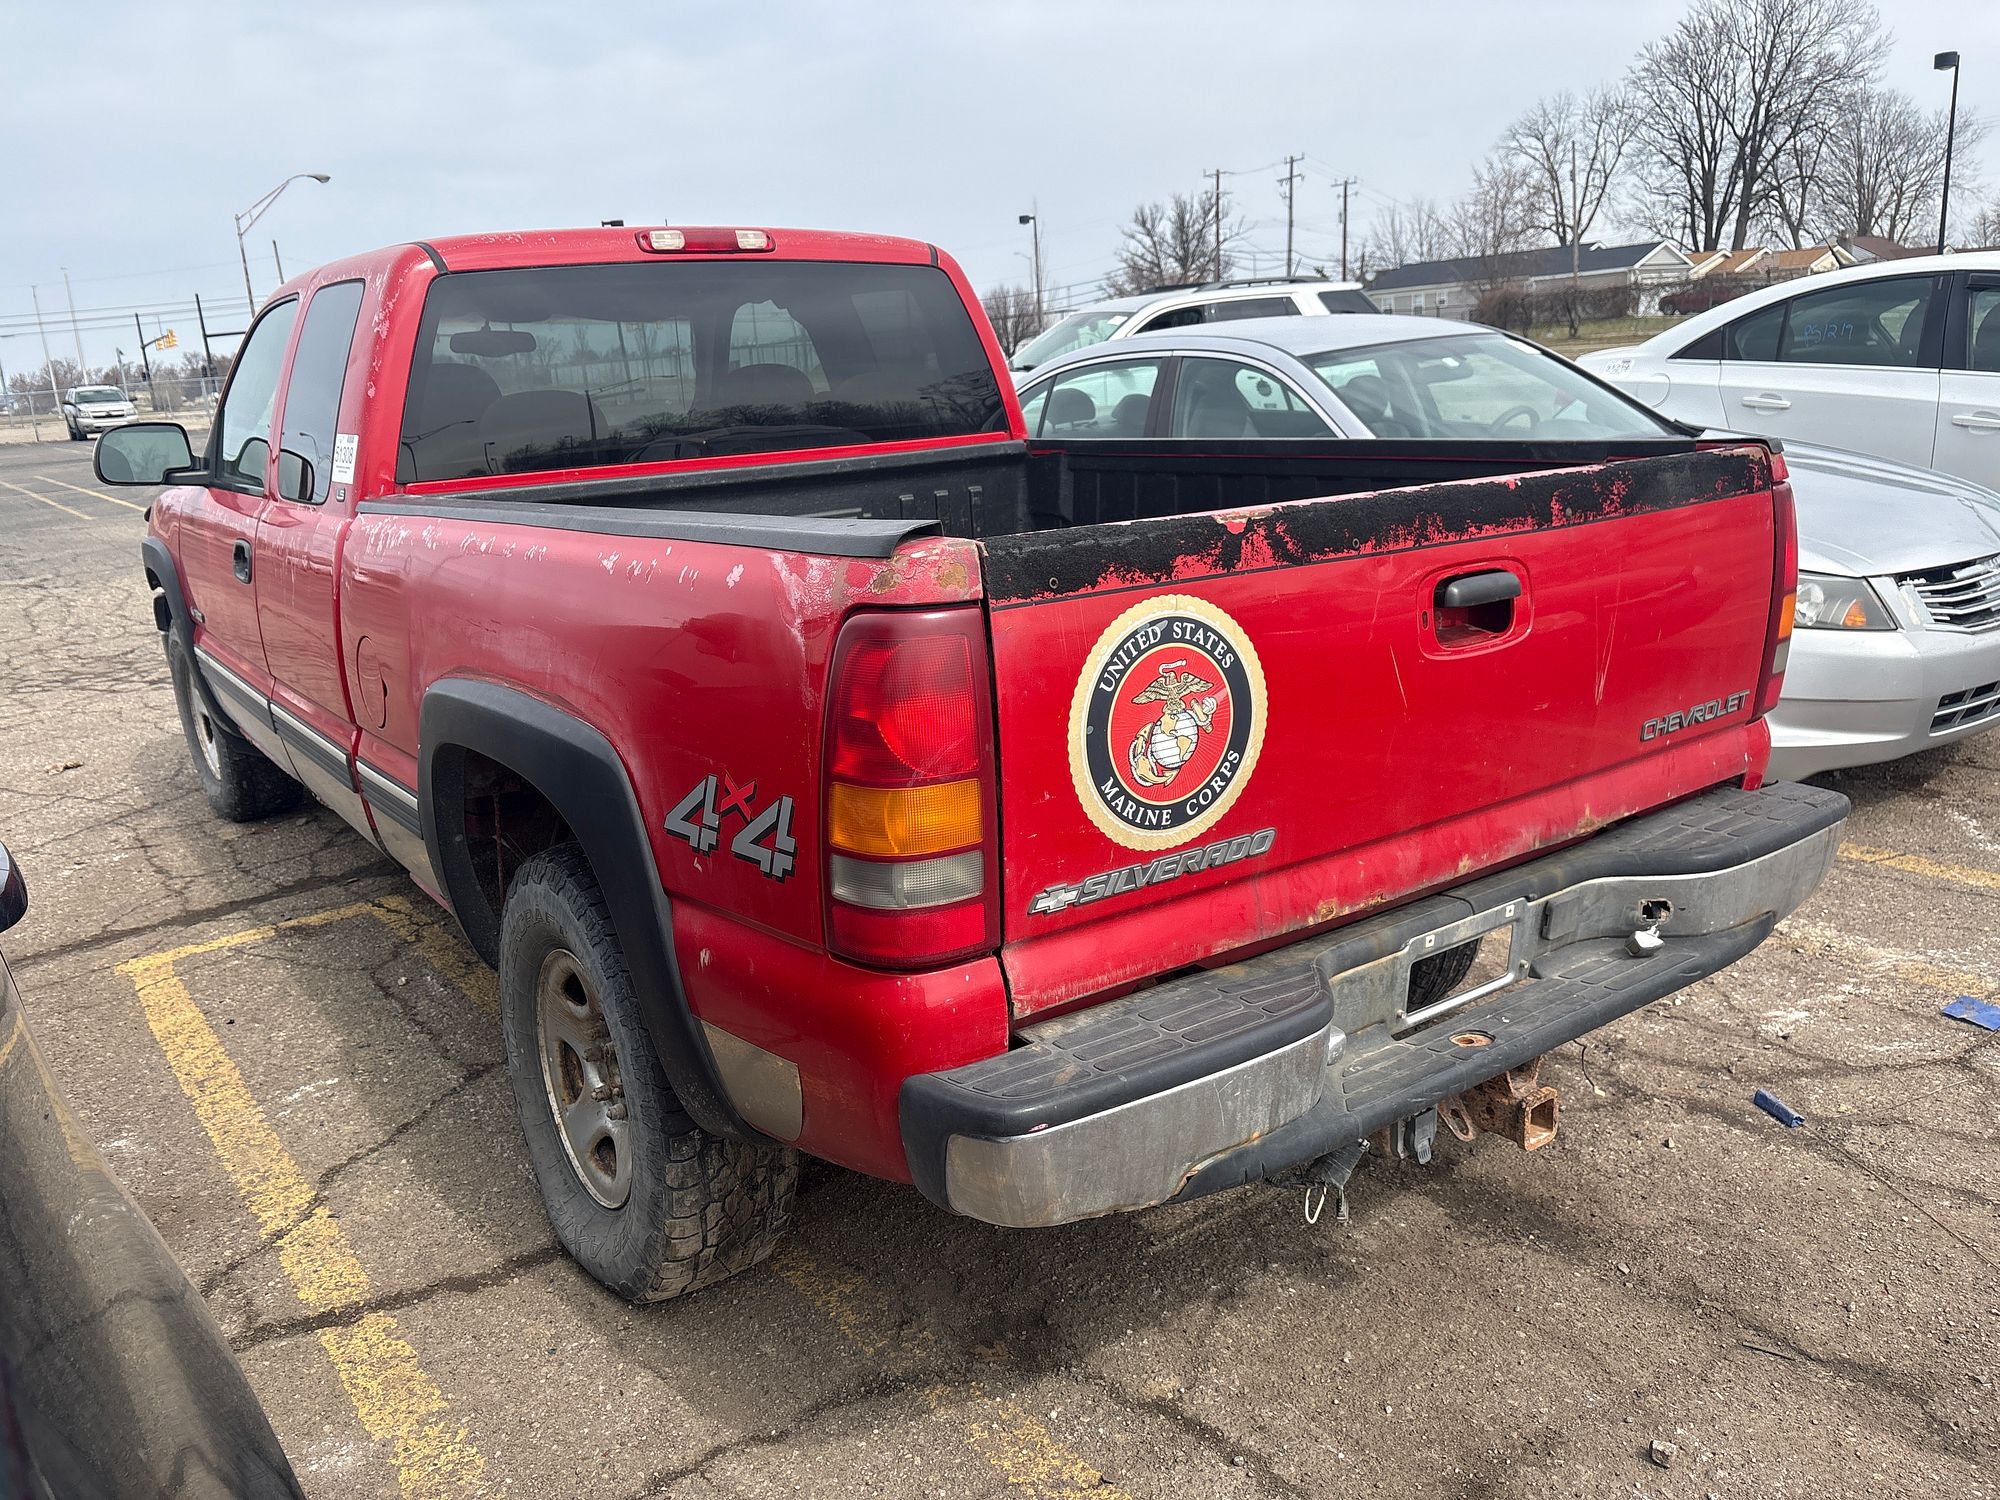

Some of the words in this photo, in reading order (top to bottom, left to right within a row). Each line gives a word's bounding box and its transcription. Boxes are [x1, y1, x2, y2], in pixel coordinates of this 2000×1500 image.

[334, 446, 354, 464] 51308
[1099, 625, 1162, 693] UNITED
[1172, 621, 1235, 669] STATES
[1640, 689, 1751, 741] CHEVROLET
[1101, 776, 1172, 826] MARINE
[1186, 750, 1240, 816] CORPS
[1077, 828, 1276, 905] SILVERADO
